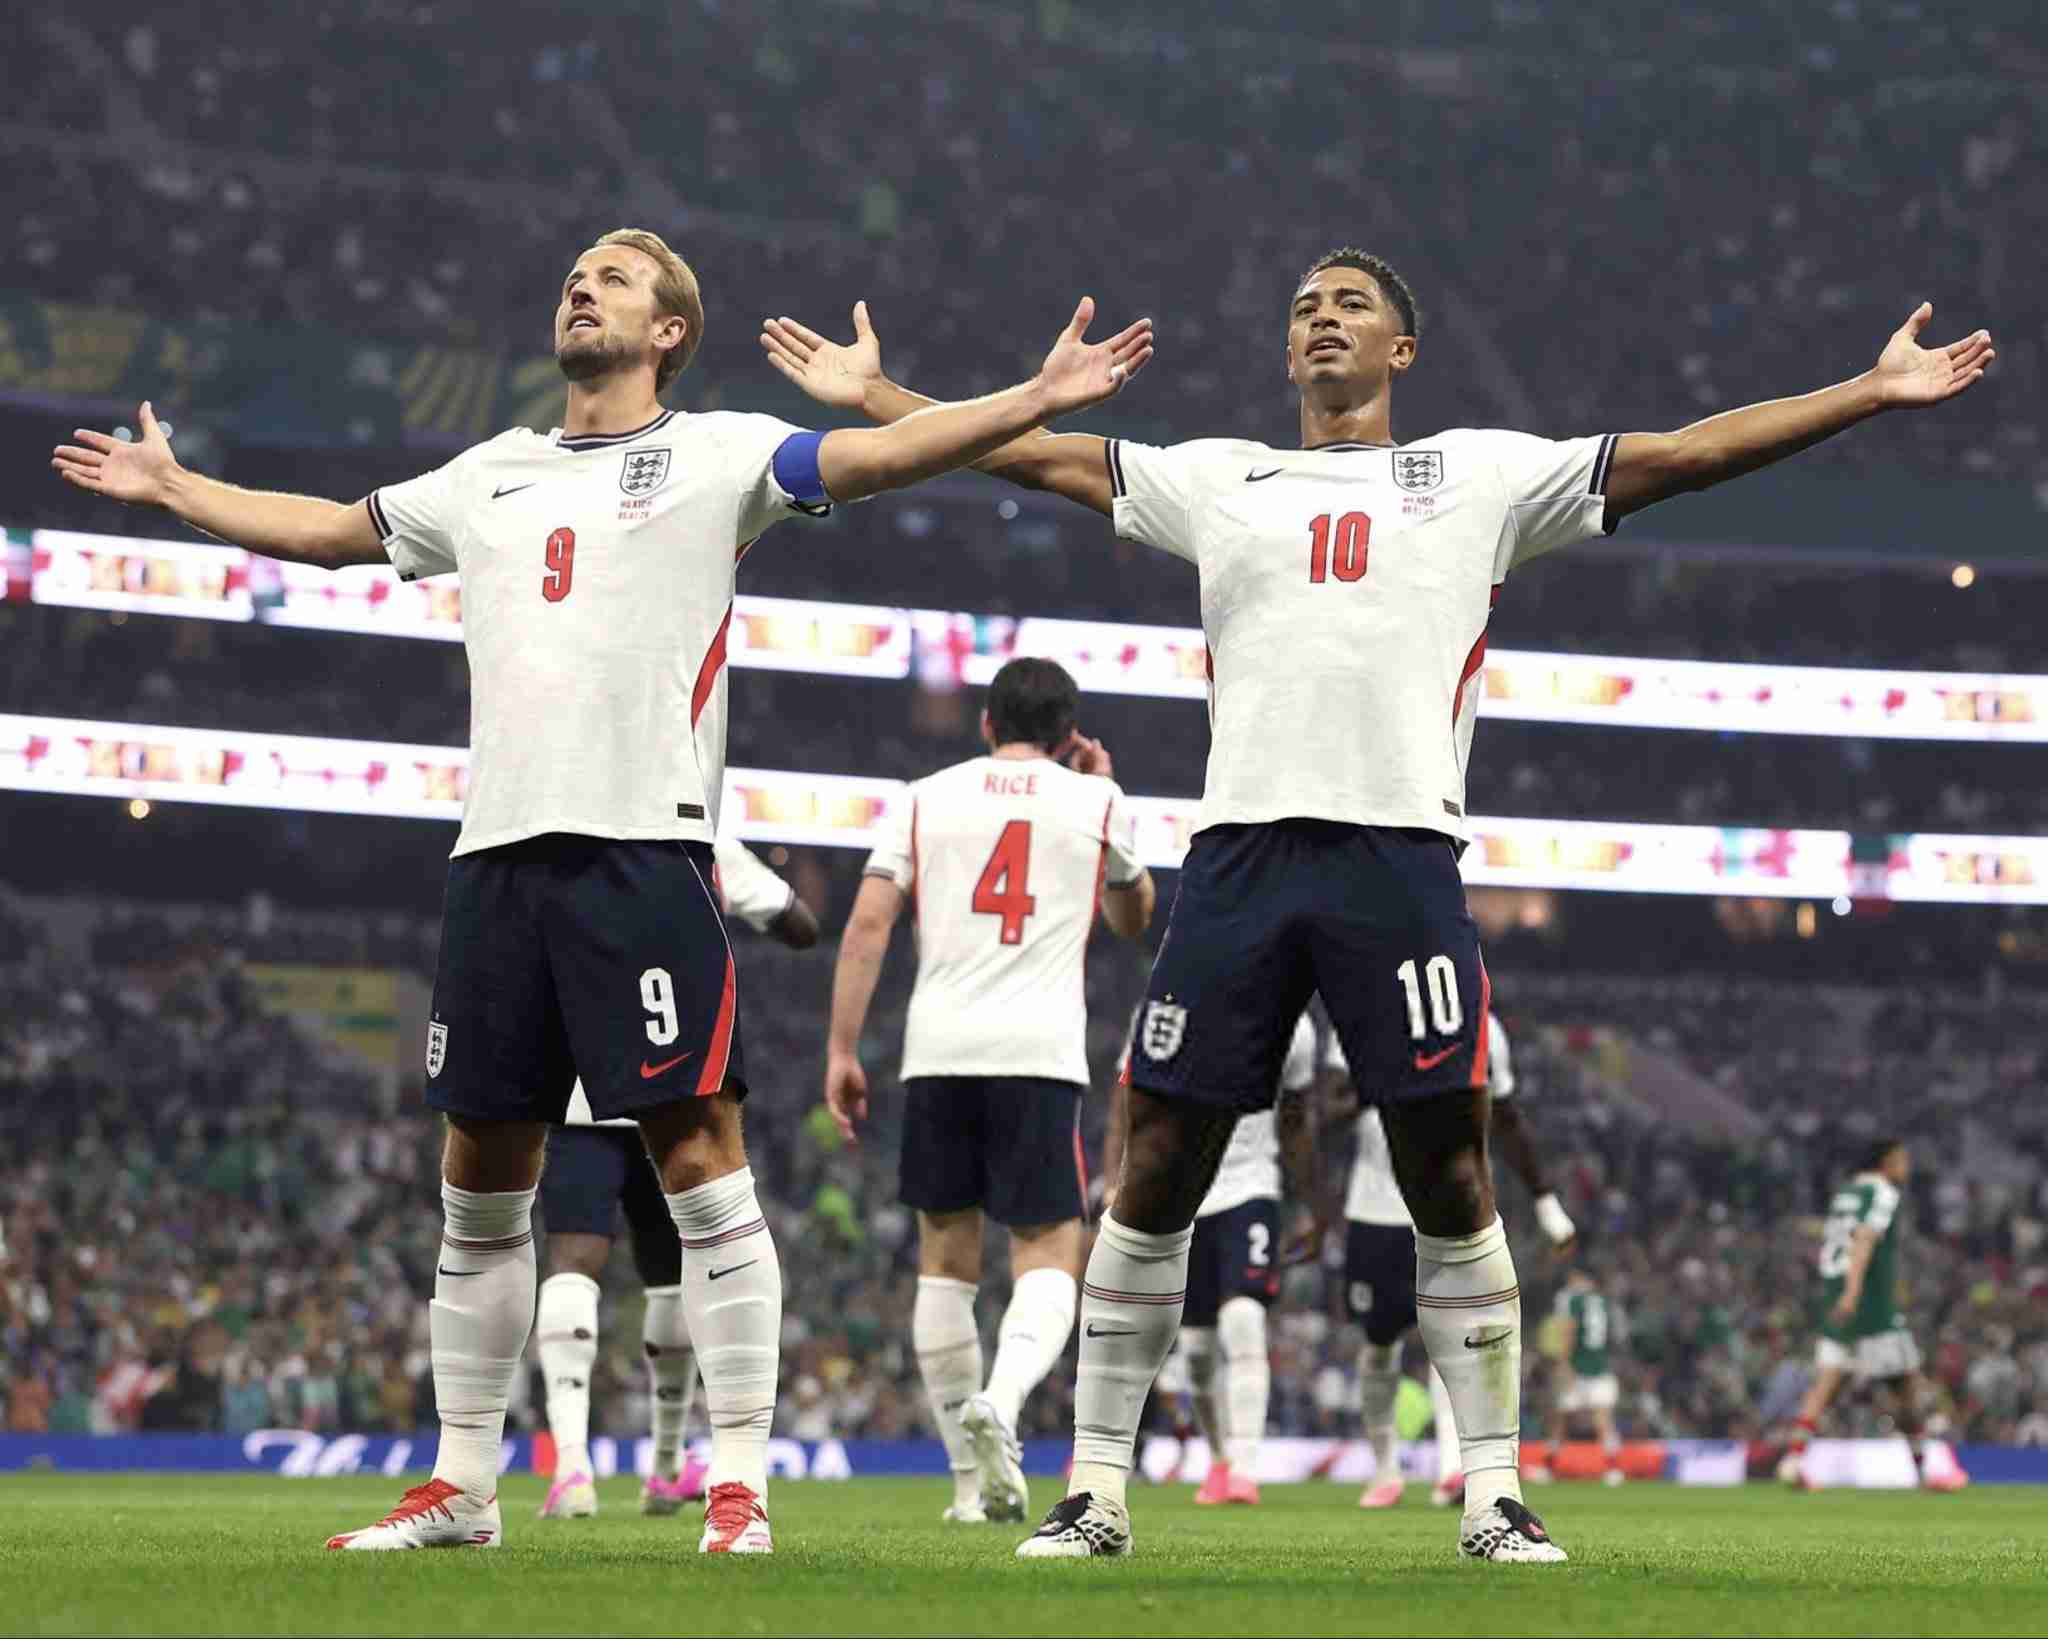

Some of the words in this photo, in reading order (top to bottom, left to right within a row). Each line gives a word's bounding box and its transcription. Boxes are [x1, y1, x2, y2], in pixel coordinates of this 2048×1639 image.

[542, 527, 576, 602] 9
[1309, 511, 1371, 583] 10
[983, 772, 1039, 795] RICE
[971, 820, 1036, 945] 4
[639, 967, 680, 1046] 9
[1397, 955, 1463, 1039] 10
[1248, 1222, 1270, 1265] 2
